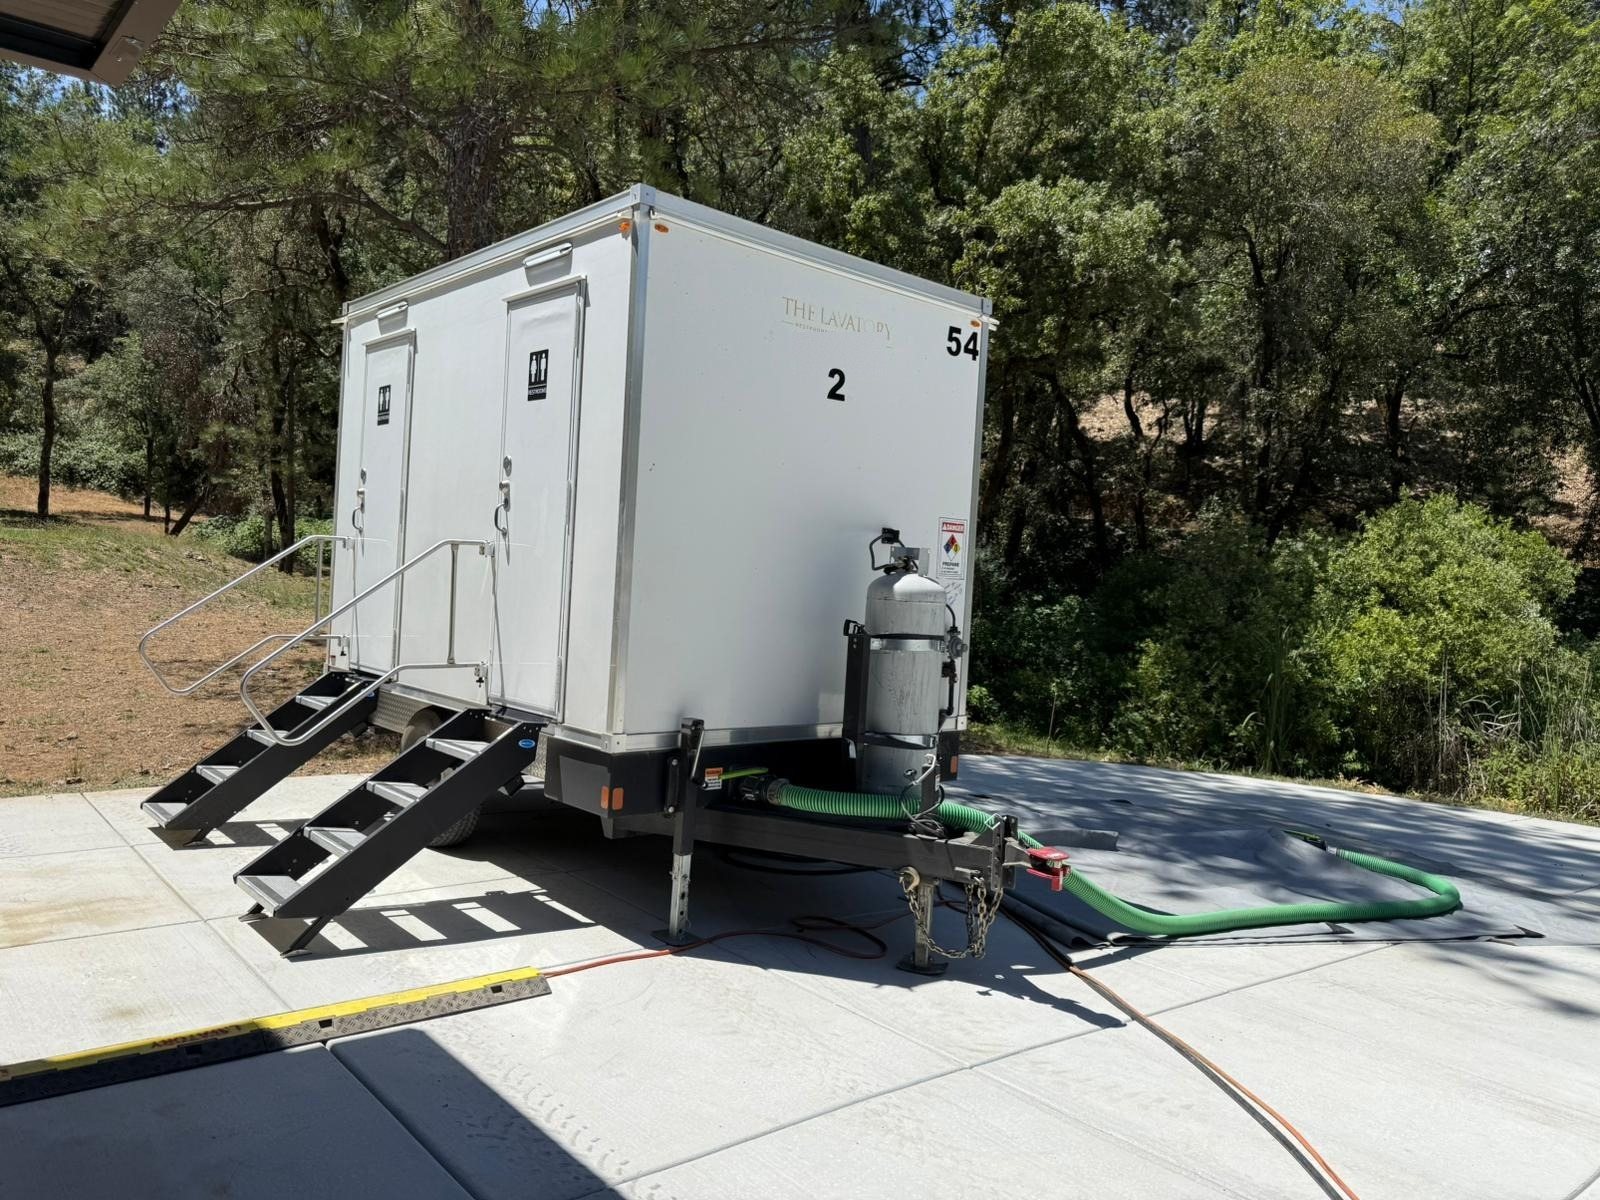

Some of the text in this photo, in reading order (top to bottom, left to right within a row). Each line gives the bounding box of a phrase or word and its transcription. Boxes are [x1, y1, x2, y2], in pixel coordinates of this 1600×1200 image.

[782, 296, 815, 321] THE
[946, 325, 979, 361] 54
[827, 368, 846, 402] 2
[946, 524, 965, 532] DANGER
